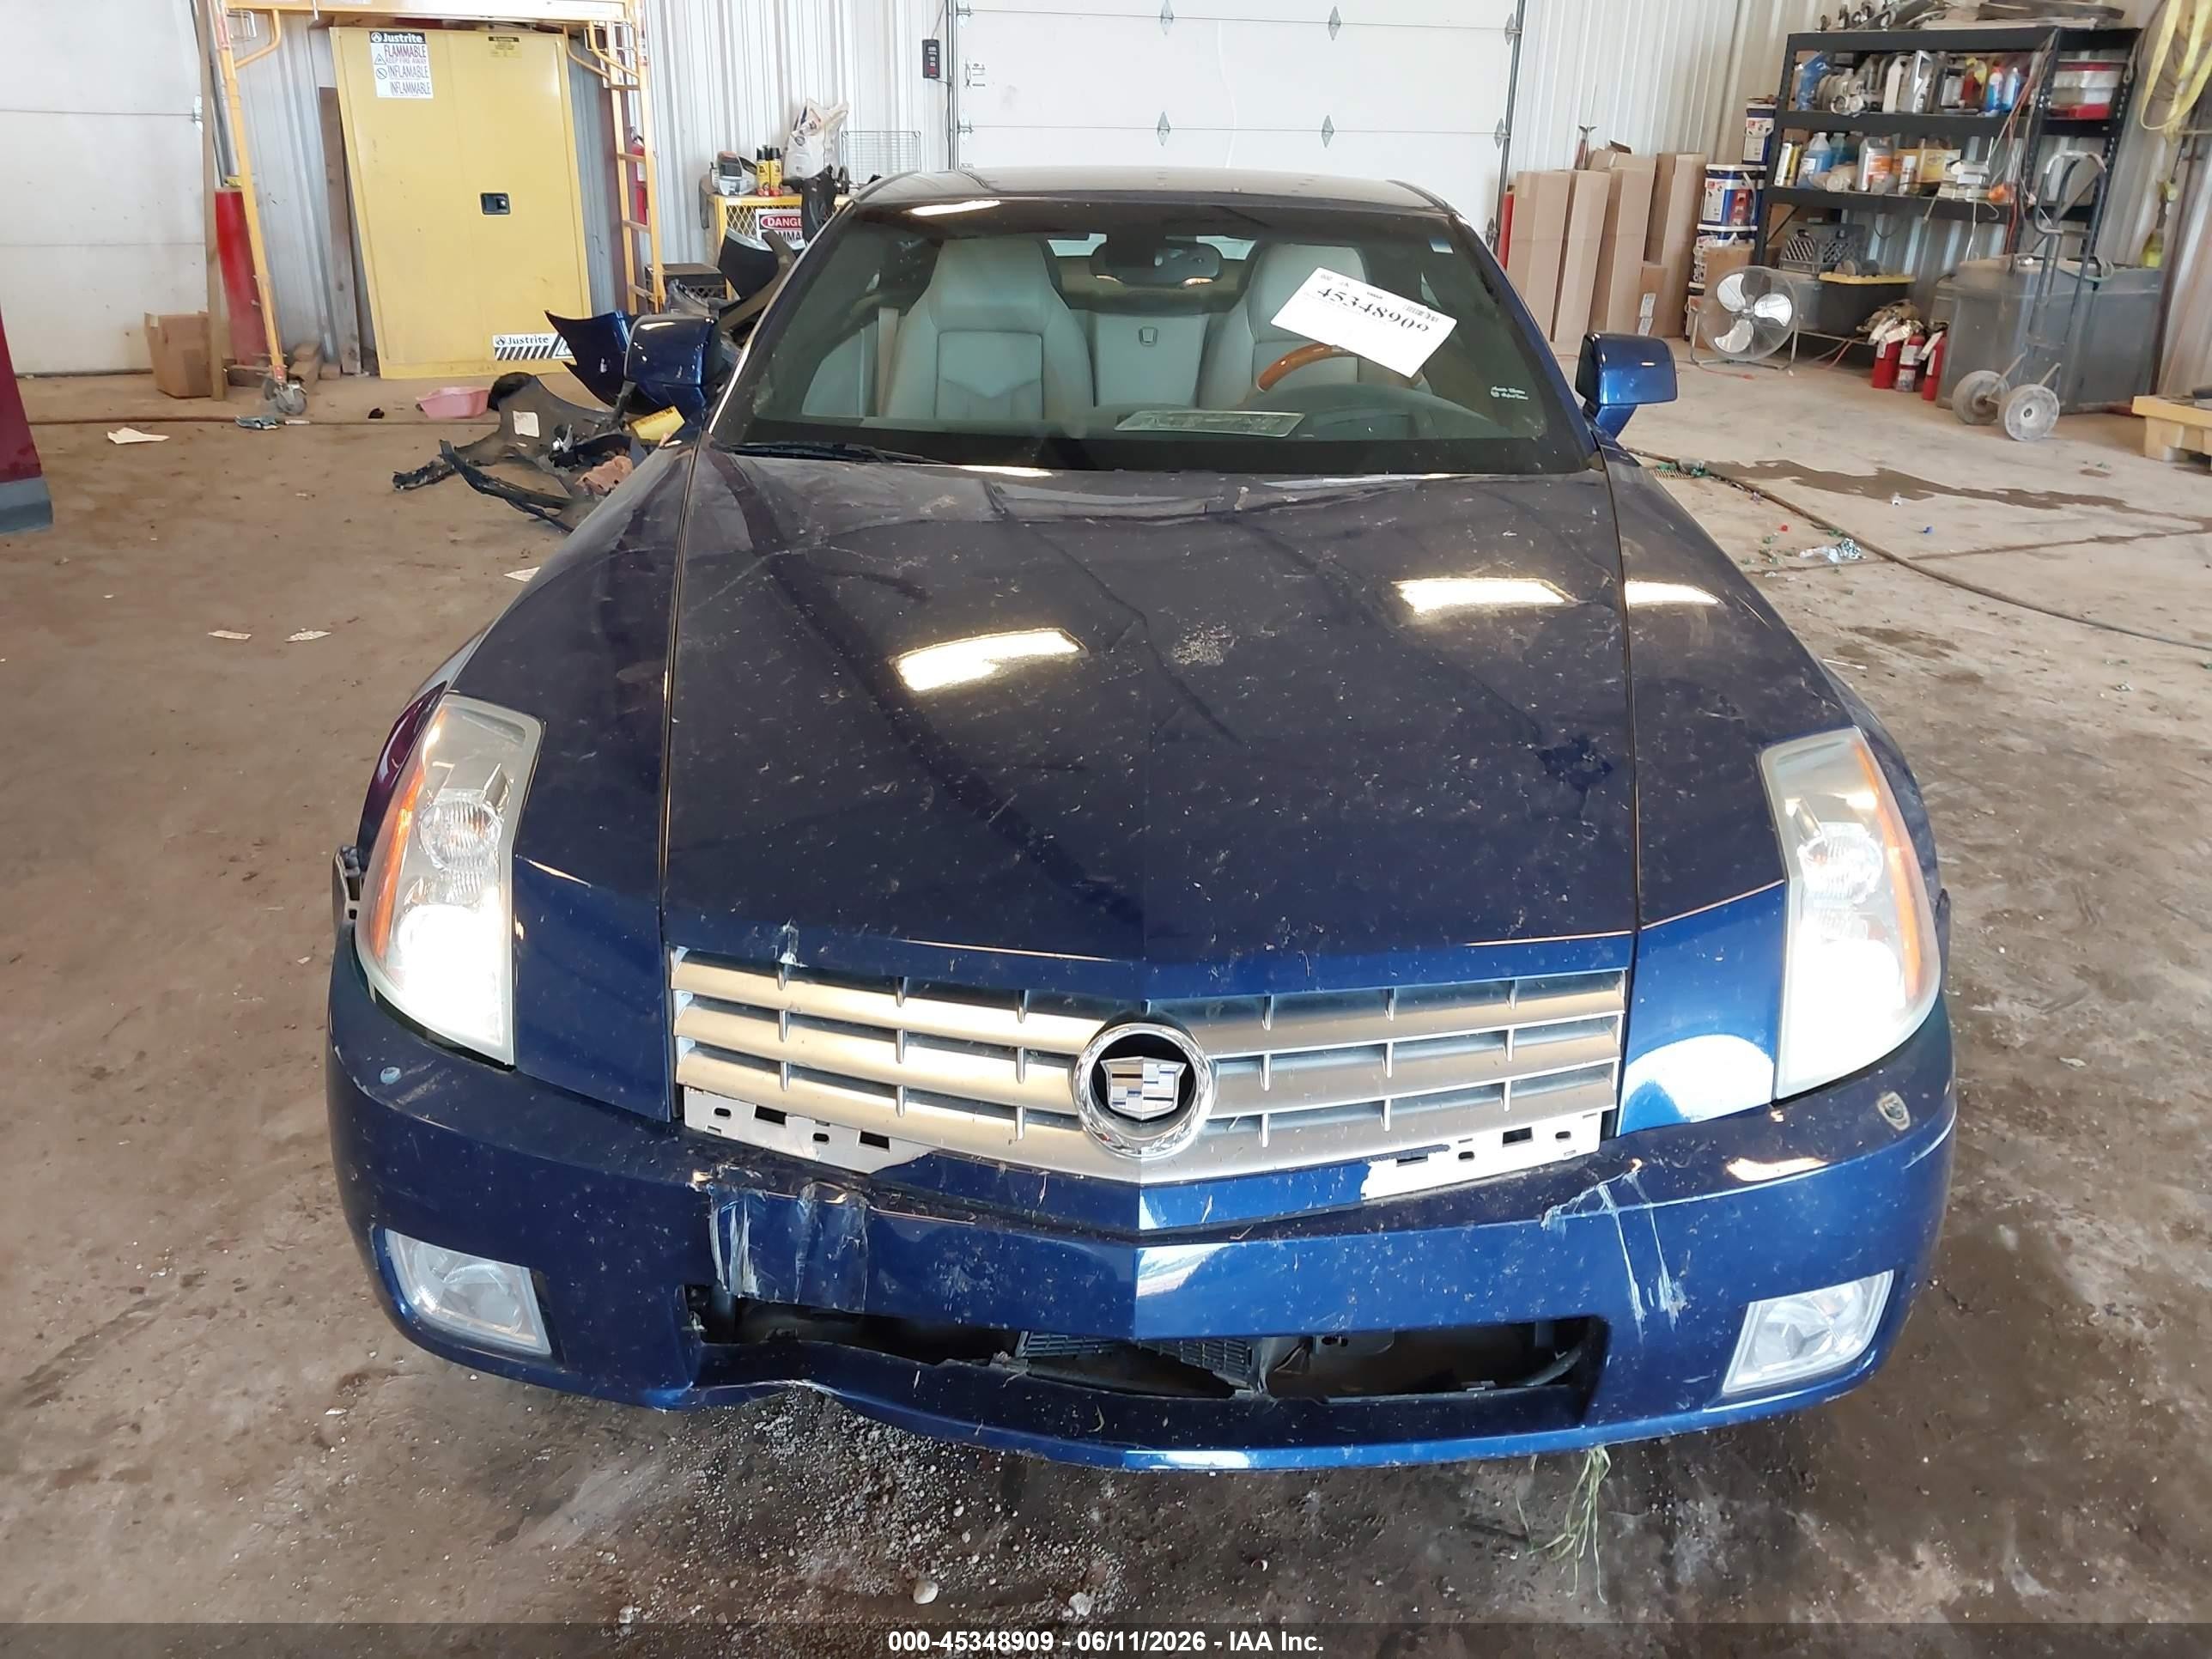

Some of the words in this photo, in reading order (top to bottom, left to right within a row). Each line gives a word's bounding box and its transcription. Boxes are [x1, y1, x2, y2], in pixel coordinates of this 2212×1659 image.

[383, 33, 423, 43] Justrite
[384, 45, 426, 58] FLAMMABLE
[387, 65, 429, 78] INFLAMABLE
[390, 82, 431, 94] INFLAMMABLE
[507, 335, 550, 345] Justrite
